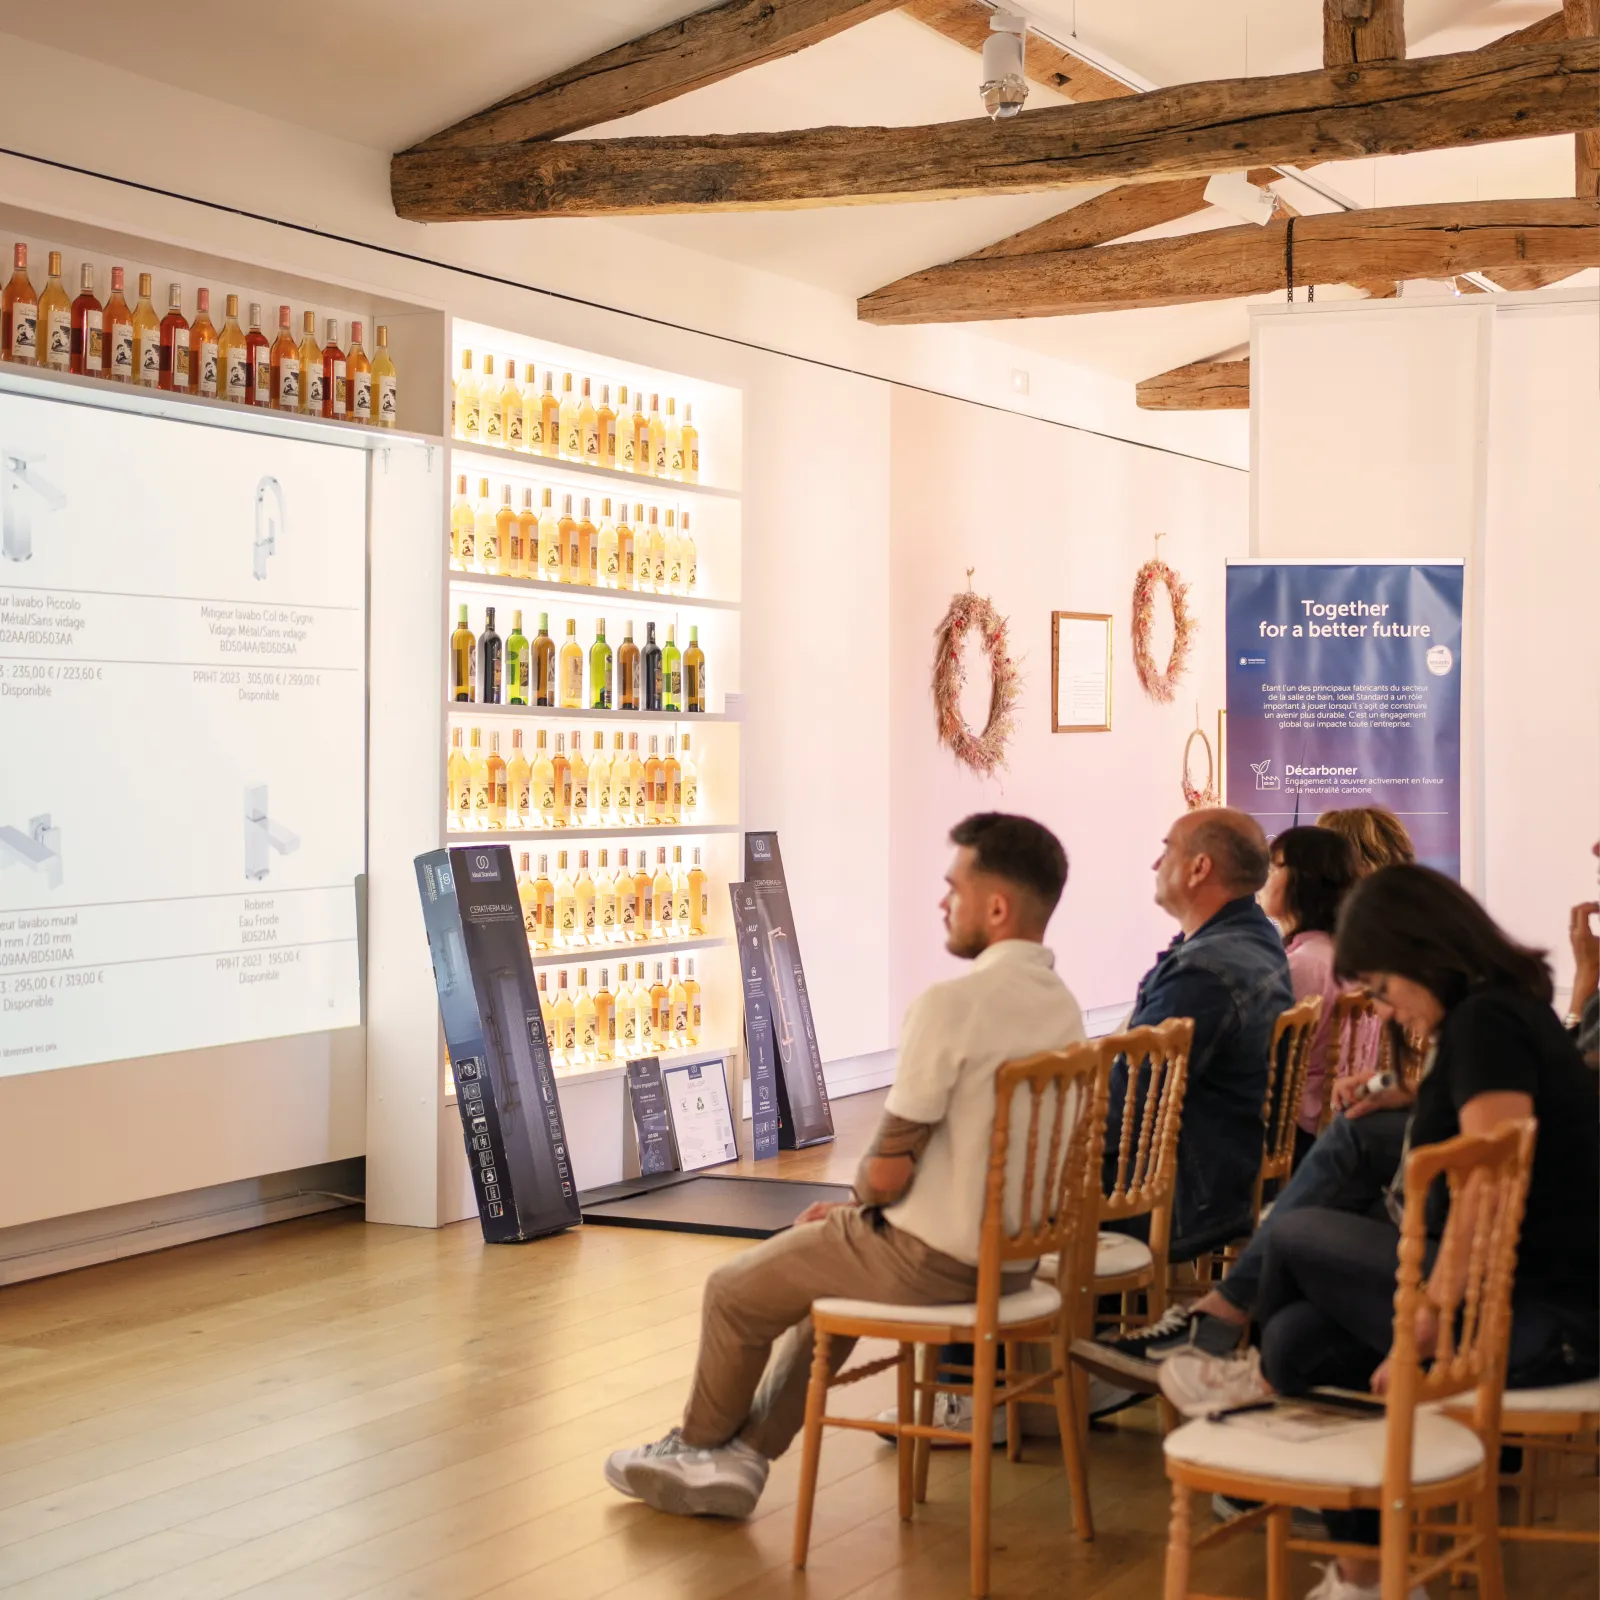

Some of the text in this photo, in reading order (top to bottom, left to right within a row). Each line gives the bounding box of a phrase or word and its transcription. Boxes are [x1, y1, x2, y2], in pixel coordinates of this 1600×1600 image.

[12, 595, 43, 608] lavabo
[46, 596, 81, 610] Piccolo
[200, 606, 314, 625] Mitigeur lavabo Col de Cygne
[1301, 600, 1390, 620] Together
[1, 612, 85, 630] Métal/Sans vidage
[209, 624, 307, 641] Vidage Métal/Sans vidage
[1259, 621, 1430, 638] for a better future
[12, 666, 45, 680] 235,00
[48, 666, 54, 679] €
[63, 666, 94, 681] 223,60
[96, 668, 102, 680] €
[220, 672, 240, 684] 2023
[247, 672, 274, 686] 305,00
[276, 673, 281, 685] €
[2, 683, 52, 698] Disponible
[238, 689, 280, 702] Disponible
[1262, 683, 1281, 692] Étant
[1313, 684, 1350, 694] principaux
[1353, 684, 1388, 692] fabricants
[1390, 684, 1400, 692] du
[1264, 702, 1299, 711] important
[1307, 702, 1326, 711] jouer
[1328, 702, 1357, 711] lorsqu'il
[1359, 702, 1378, 711] s'agit
[1300, 711, 1315, 720] plus
[1380, 712, 1426, 720] engagement
[1279, 720, 1302, 729] global
[1304, 720, 1315, 729] qui
[1316, 720, 1347, 729] impacte
[1370, 720, 1412, 729] l'entreprise.
[1285, 765, 1358, 776] Décarboner
[1285, 778, 1332, 786] Engagement
[245, 899, 274, 910] Robinet
[470, 905, 500, 914] CERATHERM
[18, 916, 49, 929] lavabo
[51, 914, 78, 926] mural
[239, 914, 279, 927] Eau Froide
[4, 938, 24, 948] mm
[33, 932, 50, 946] 210
[52, 934, 71, 944] mm
[242, 930, 277, 943] BD521AA
[269, 952, 294, 965] 195,00
[0, 981, 6, 993] 3
[14, 977, 47, 993] 295,00
[50, 976, 56, 988] €
[65, 972, 96, 987] 319,00
[98, 970, 104, 984] €
[239, 970, 279, 984] Disponible
[4, 994, 54, 1012] Disponible
